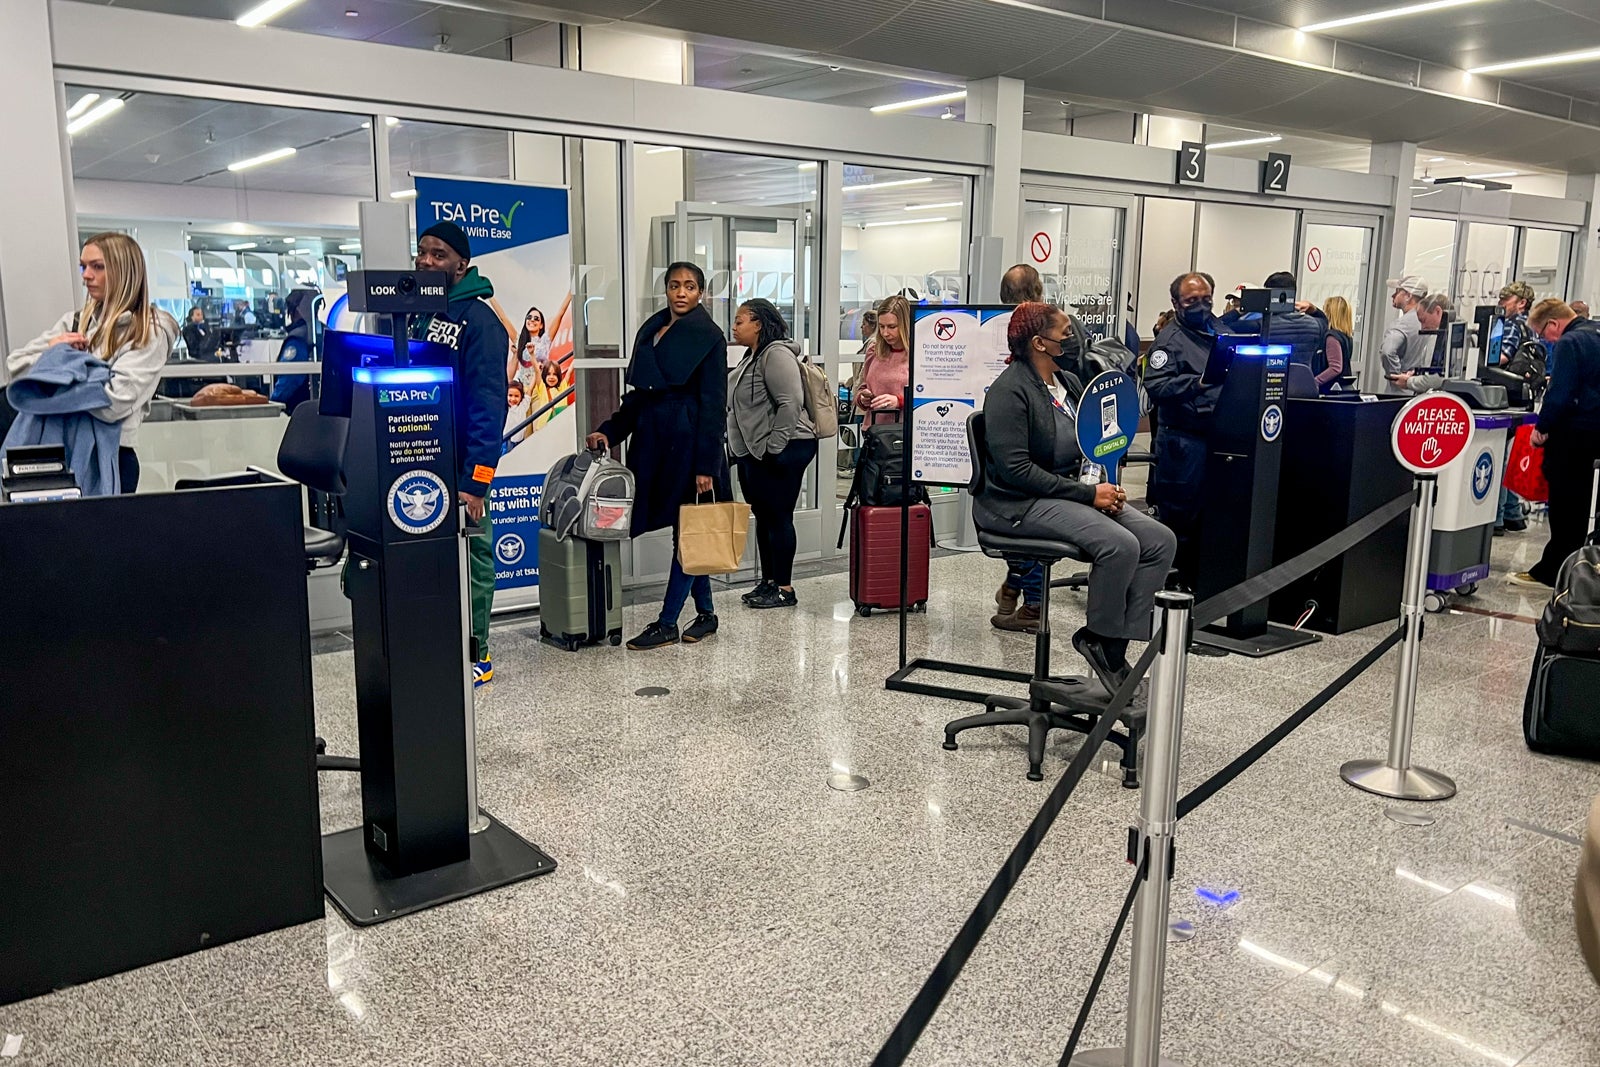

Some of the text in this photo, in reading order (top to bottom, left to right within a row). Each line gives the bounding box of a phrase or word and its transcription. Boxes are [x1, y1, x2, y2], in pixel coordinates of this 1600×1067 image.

[1185, 147, 1201, 179] 3
[1269, 159, 1285, 189] 2
[430, 201, 467, 222] TSA
[466, 226, 489, 238] With
[490, 227, 512, 240] Ease
[1056, 273, 1111, 289] beyond this
[370, 286, 444, 296] LOOK HERE
[1054, 291, 1096, 305] Violators
[1097, 294, 1113, 305] are
[1106, 314, 1116, 325] or
[1099, 376, 1124, 391] DELTA
[389, 390, 409, 402] TSA
[388, 414, 439, 424] Participation
[1417, 408, 1457, 421] PLEASE
[388, 423, 433, 433] is optional.
[1404, 421, 1466, 435] WAIT HERE
[389, 440, 410, 449] Notify
[411, 439, 432, 447] officer
[1103, 440, 1121, 452] DIGITAL
[390, 449, 403, 457] you
[413, 447, 425, 455] not
[425, 446, 441, 454] want
[396, 456, 415, 464] photo
[416, 454, 436, 462] taken.
[499, 486, 529, 498] stress
[507, 497, 530, 510] with
[498, 516, 517, 524] under
[516, 515, 529, 524] join
[515, 568, 524, 577] at
